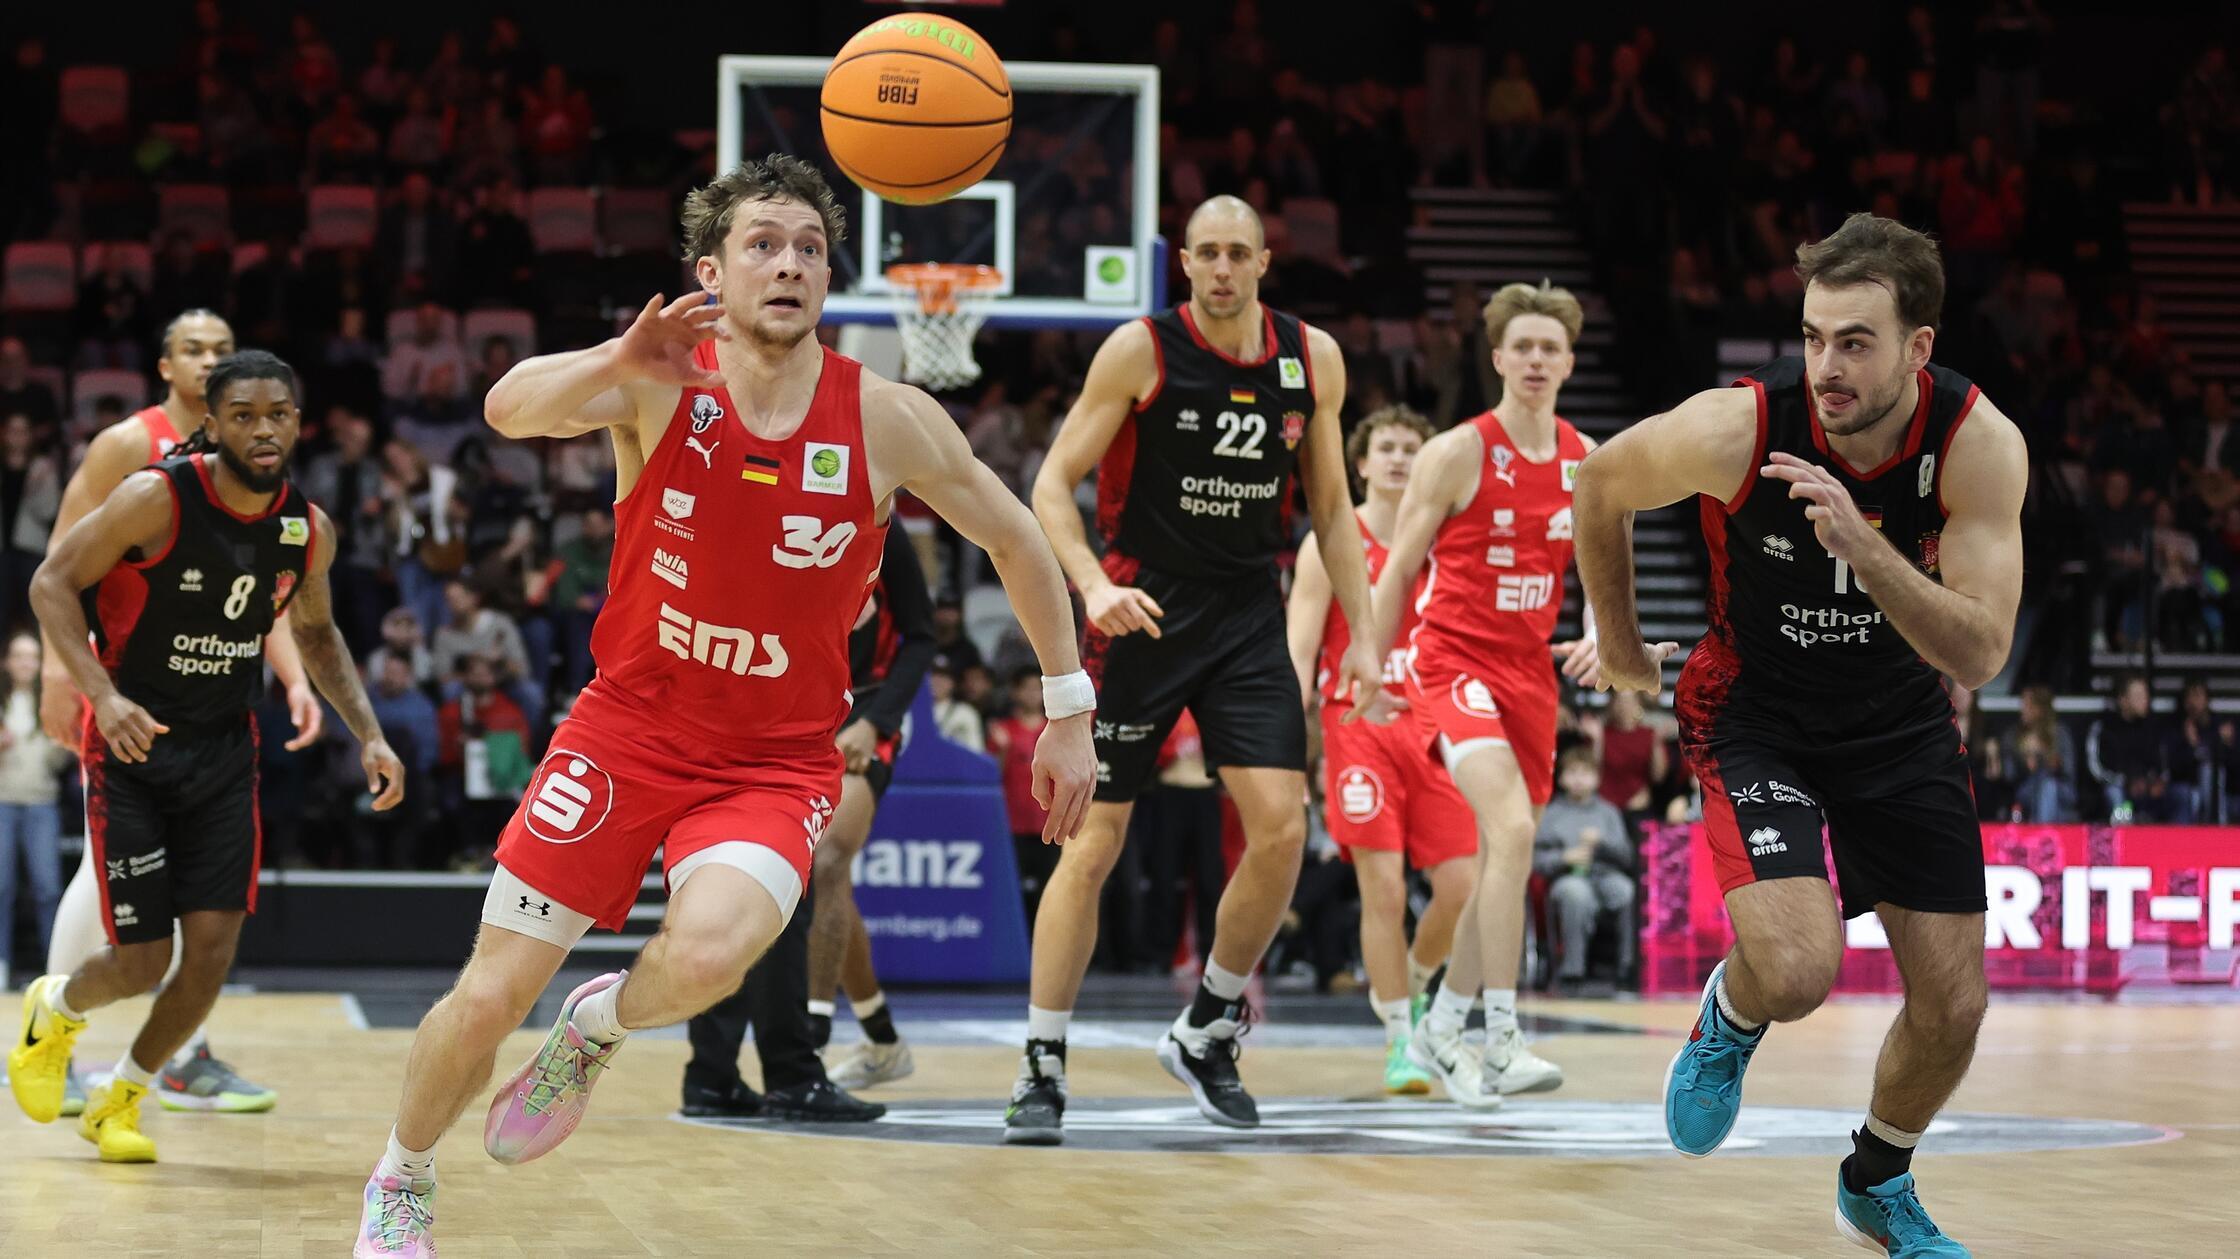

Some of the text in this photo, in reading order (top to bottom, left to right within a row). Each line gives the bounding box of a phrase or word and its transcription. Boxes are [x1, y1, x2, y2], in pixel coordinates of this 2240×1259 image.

[878, 84, 918, 105] FIBA
[1213, 411, 1267, 460] 22
[1180, 496, 1242, 518] sport
[772, 515, 858, 569] 30
[1763, 546, 1794, 561] errea
[1827, 548, 1869, 594] 1
[223, 574, 256, 620] 8
[168, 655, 233, 675] sport
[1752, 842, 1788, 857] errea
